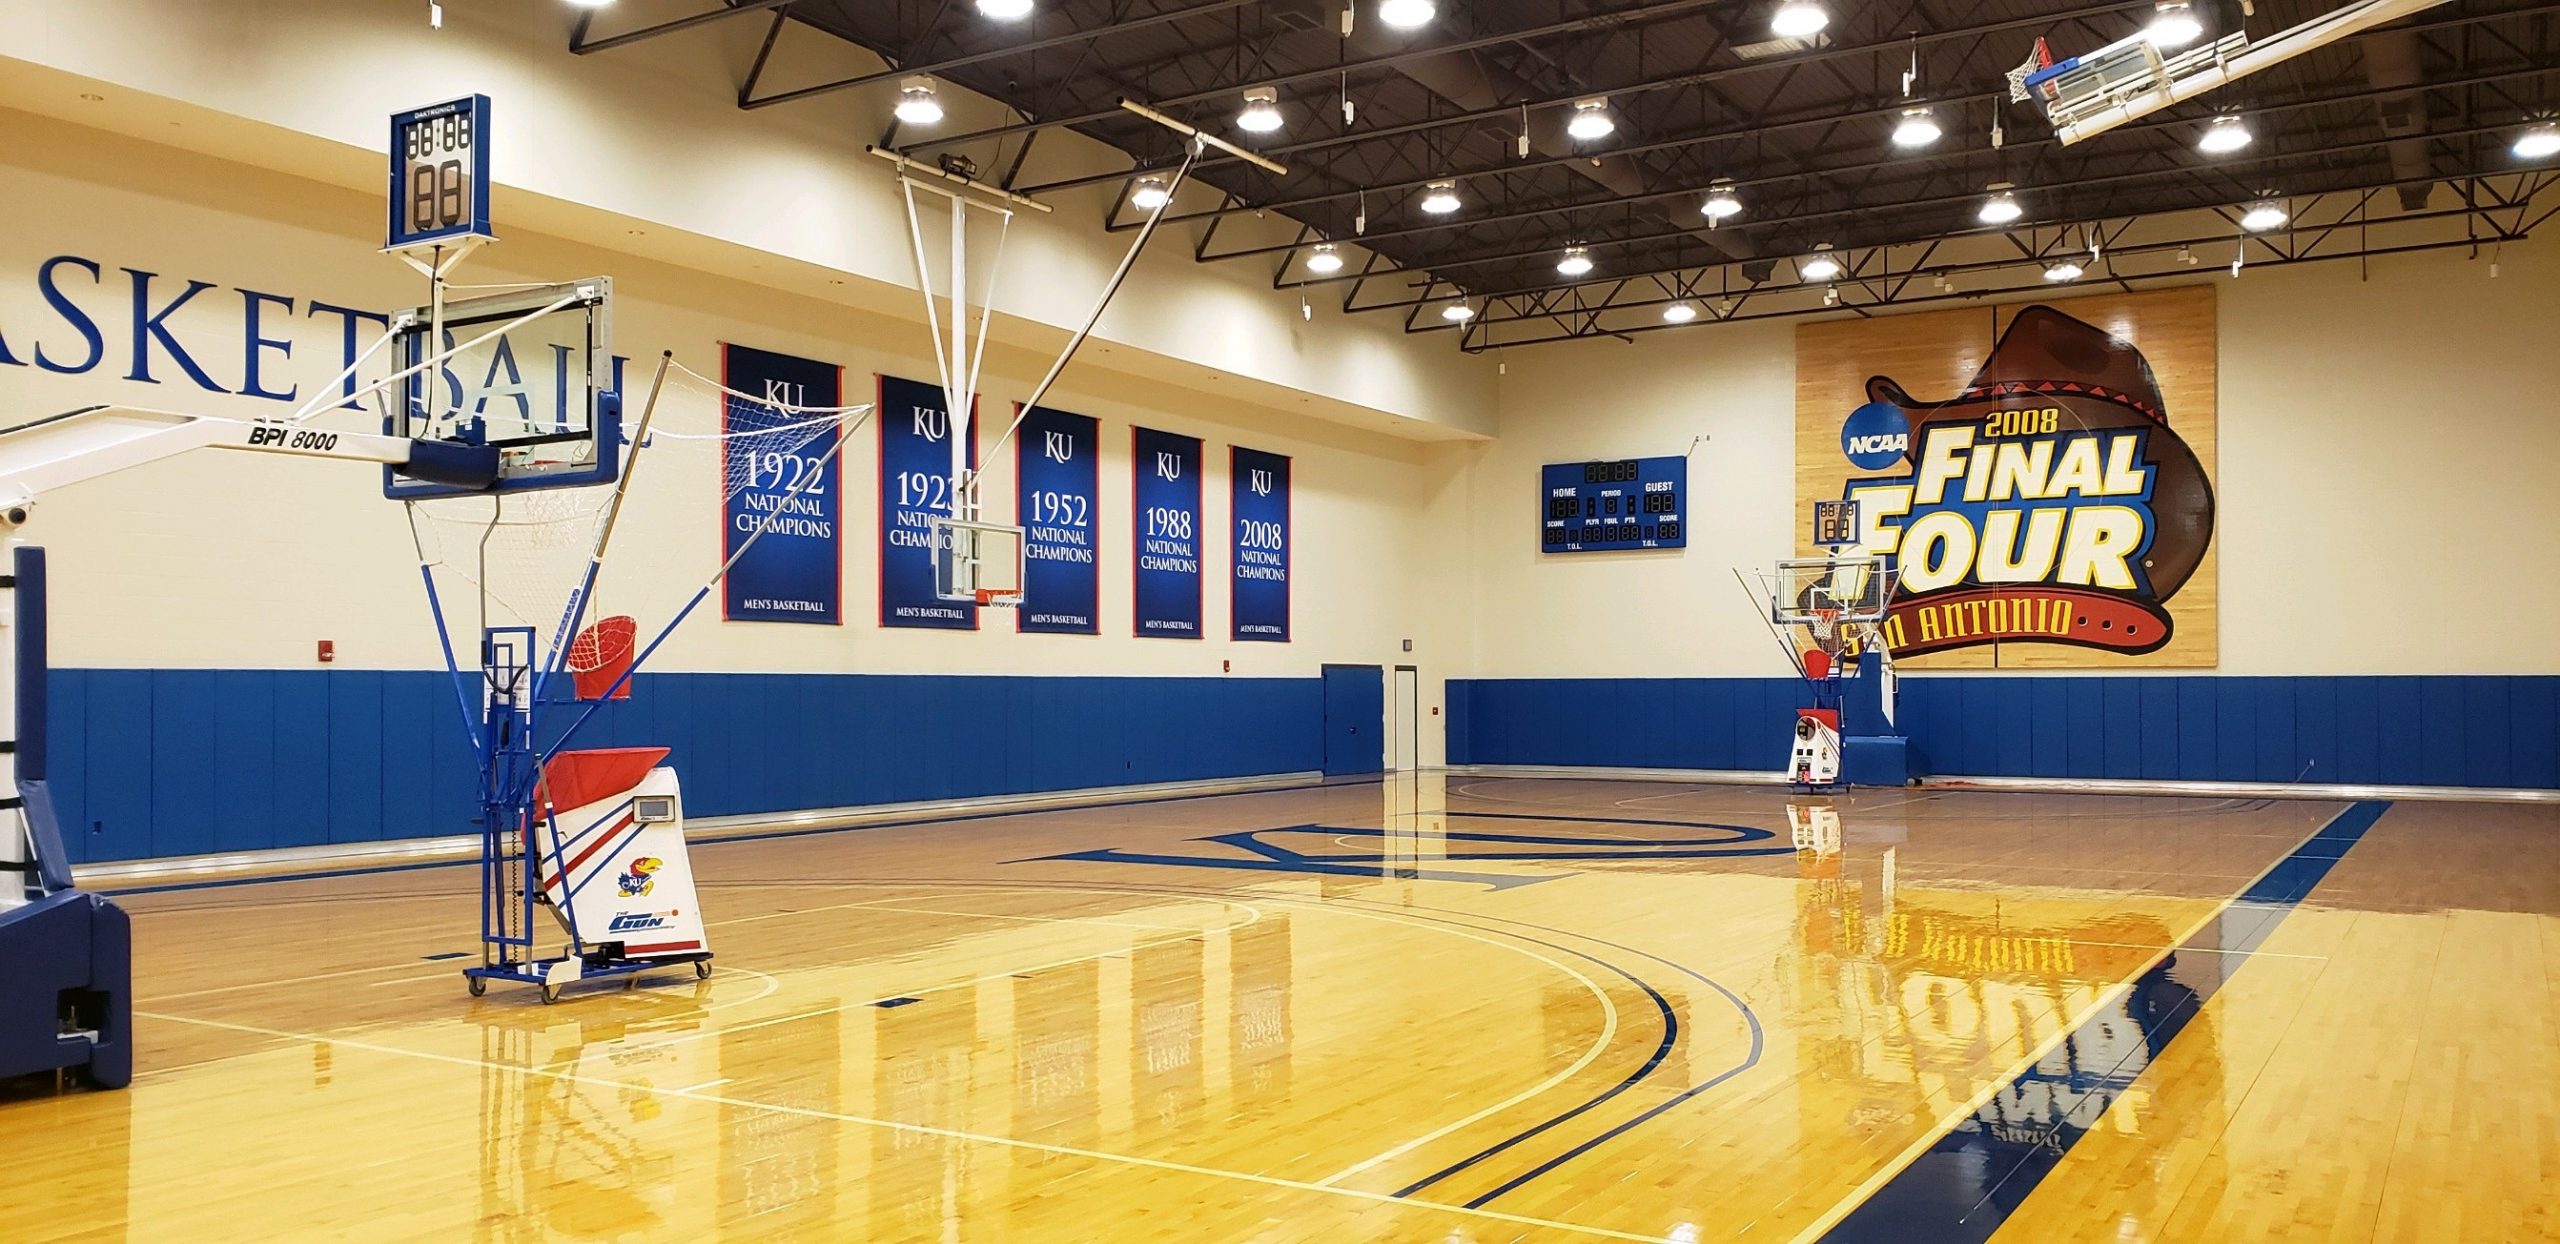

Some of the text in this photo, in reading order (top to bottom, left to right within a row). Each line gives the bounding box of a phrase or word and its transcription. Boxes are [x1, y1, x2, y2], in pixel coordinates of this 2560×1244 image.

[415, 105, 456, 119] DAKTRONICS
[764, 379, 804, 419] KU
[913, 406, 946, 442] KU
[1985, 408, 2059, 437] 2008
[248, 427, 338, 451] BPI 8000
[1045, 430, 1073, 464] KU
[1848, 433, 1908, 454] NCAA
[745, 450, 825, 494] 1922
[1157, 452, 1181, 482] KU
[1914, 426, 2147, 504] FINAL
[1251, 469, 1272, 497] KU
[1553, 488, 1576, 497] HOME
[1601, 489, 1622, 497] PERIOD
[1645, 481, 1673, 492] GUEST
[745, 492, 824, 516] NATIONAL
[1031, 490, 1087, 527] 1952
[736, 514, 831, 538] CHAMPIONS
[1146, 507, 1192, 539] 1988
[1547, 520, 1565, 528] SCORE
[1586, 518, 1599, 526] PLYR
[1604, 517, 1618, 525] FOUL
[1659, 514, 1678, 522] SCORE
[1032, 526, 1087, 545] NATIONAL
[1240, 519, 1282, 550] 2008
[1828, 484, 2144, 601] FOUR
[1026, 544, 1092, 563] CHAMPIONS
[1146, 540, 1192, 556] NATIONAL
[1141, 556, 1197, 573] CHAMPIONS
[1241, 551, 1281, 566] NATIONAL
[1237, 566, 1285, 581] CHAMPIONS
[744, 599, 825, 611] MEN'S BASKETBALL
[896, 607, 964, 619] MEN'S BASKETBALL
[1031, 614, 1088, 625] MEN'S BASKETBALL
[1145, 620, 1193, 630] MEN'S BASKETBALL
[1918, 598, 2073, 642] ANTONIO
[1255, 626, 1282, 634] BASKETBALL
[1841, 614, 1909, 657] SN
[997, 812, 1797, 892] KU
[608, 913, 664, 931] GUN
